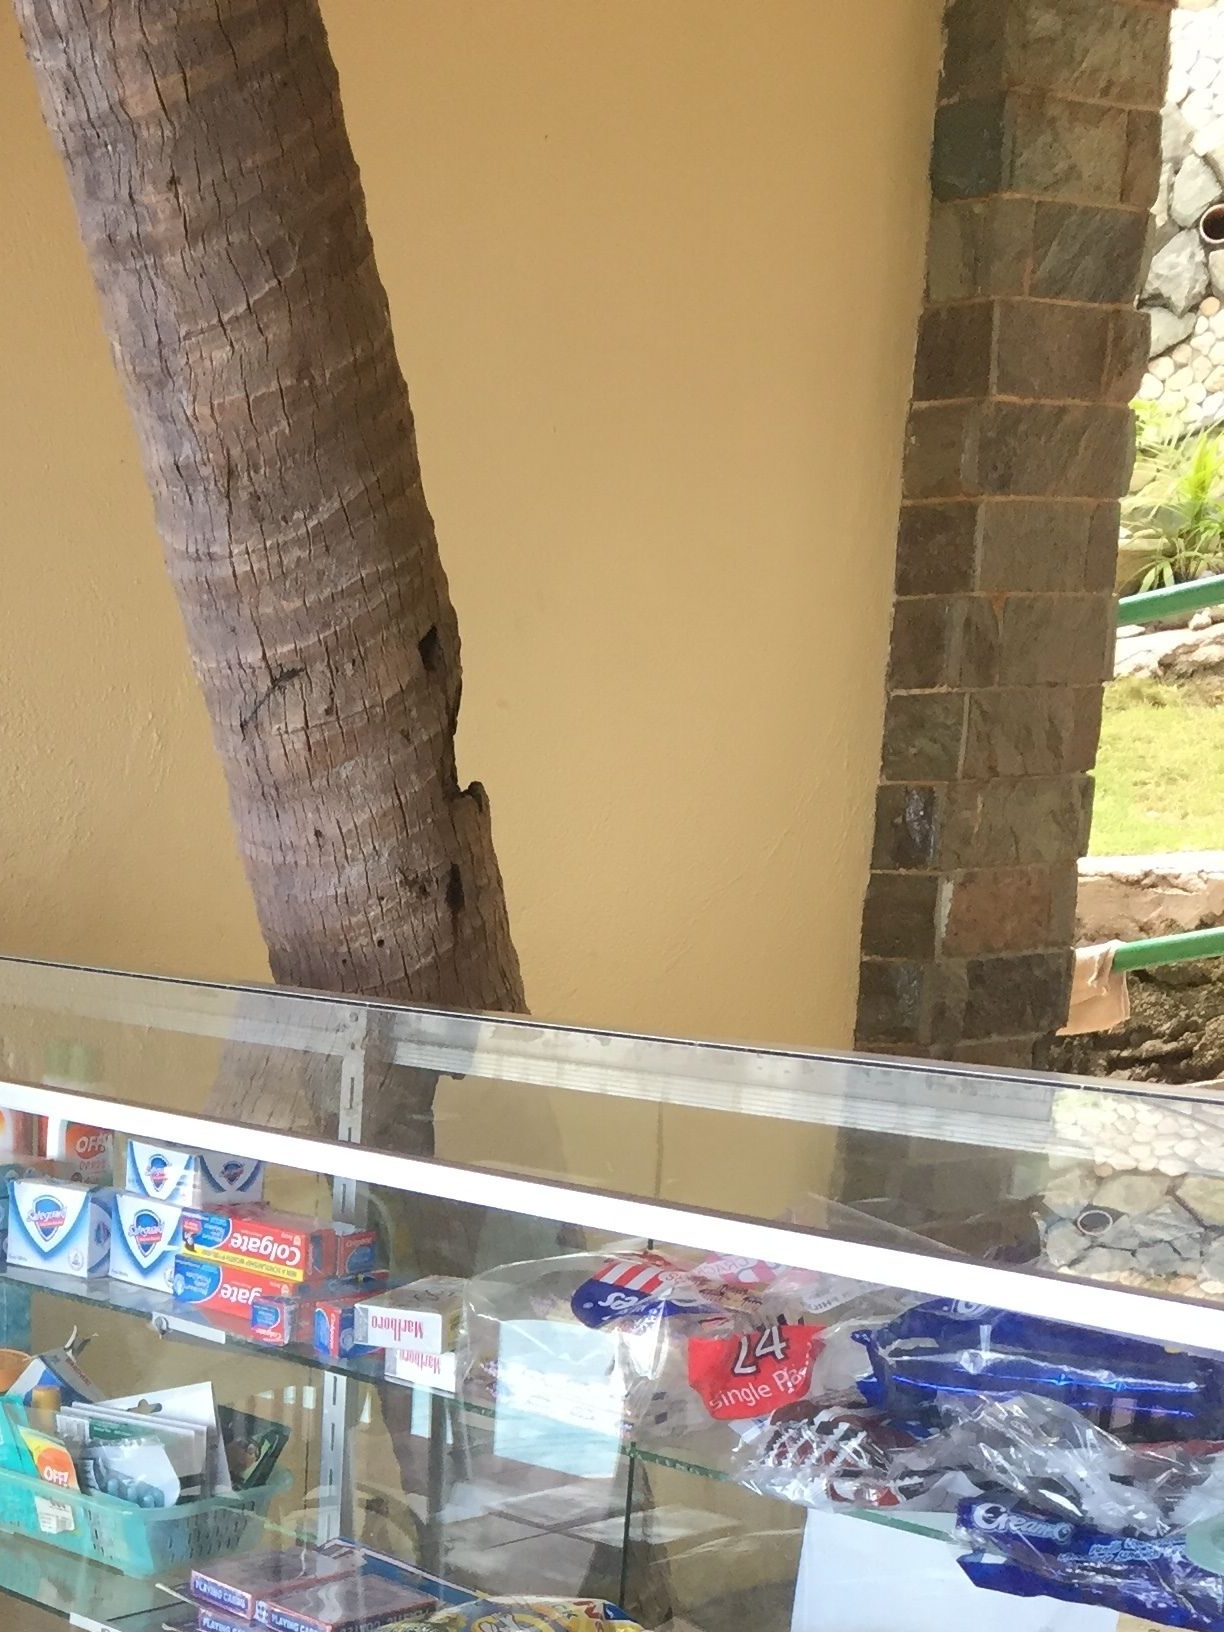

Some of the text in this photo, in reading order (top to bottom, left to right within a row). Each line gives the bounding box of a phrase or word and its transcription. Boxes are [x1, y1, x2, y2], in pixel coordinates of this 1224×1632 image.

[231, 1231, 302, 1267] Colgate
[219, 1282, 263, 1306] gate
[371, 1314, 424, 1342] Marlboro
[43, 1465, 70, 1487] OFF!
[195, 1579, 222, 1600] PLAYING
[272, 1613, 299, 1632] PLAYING
